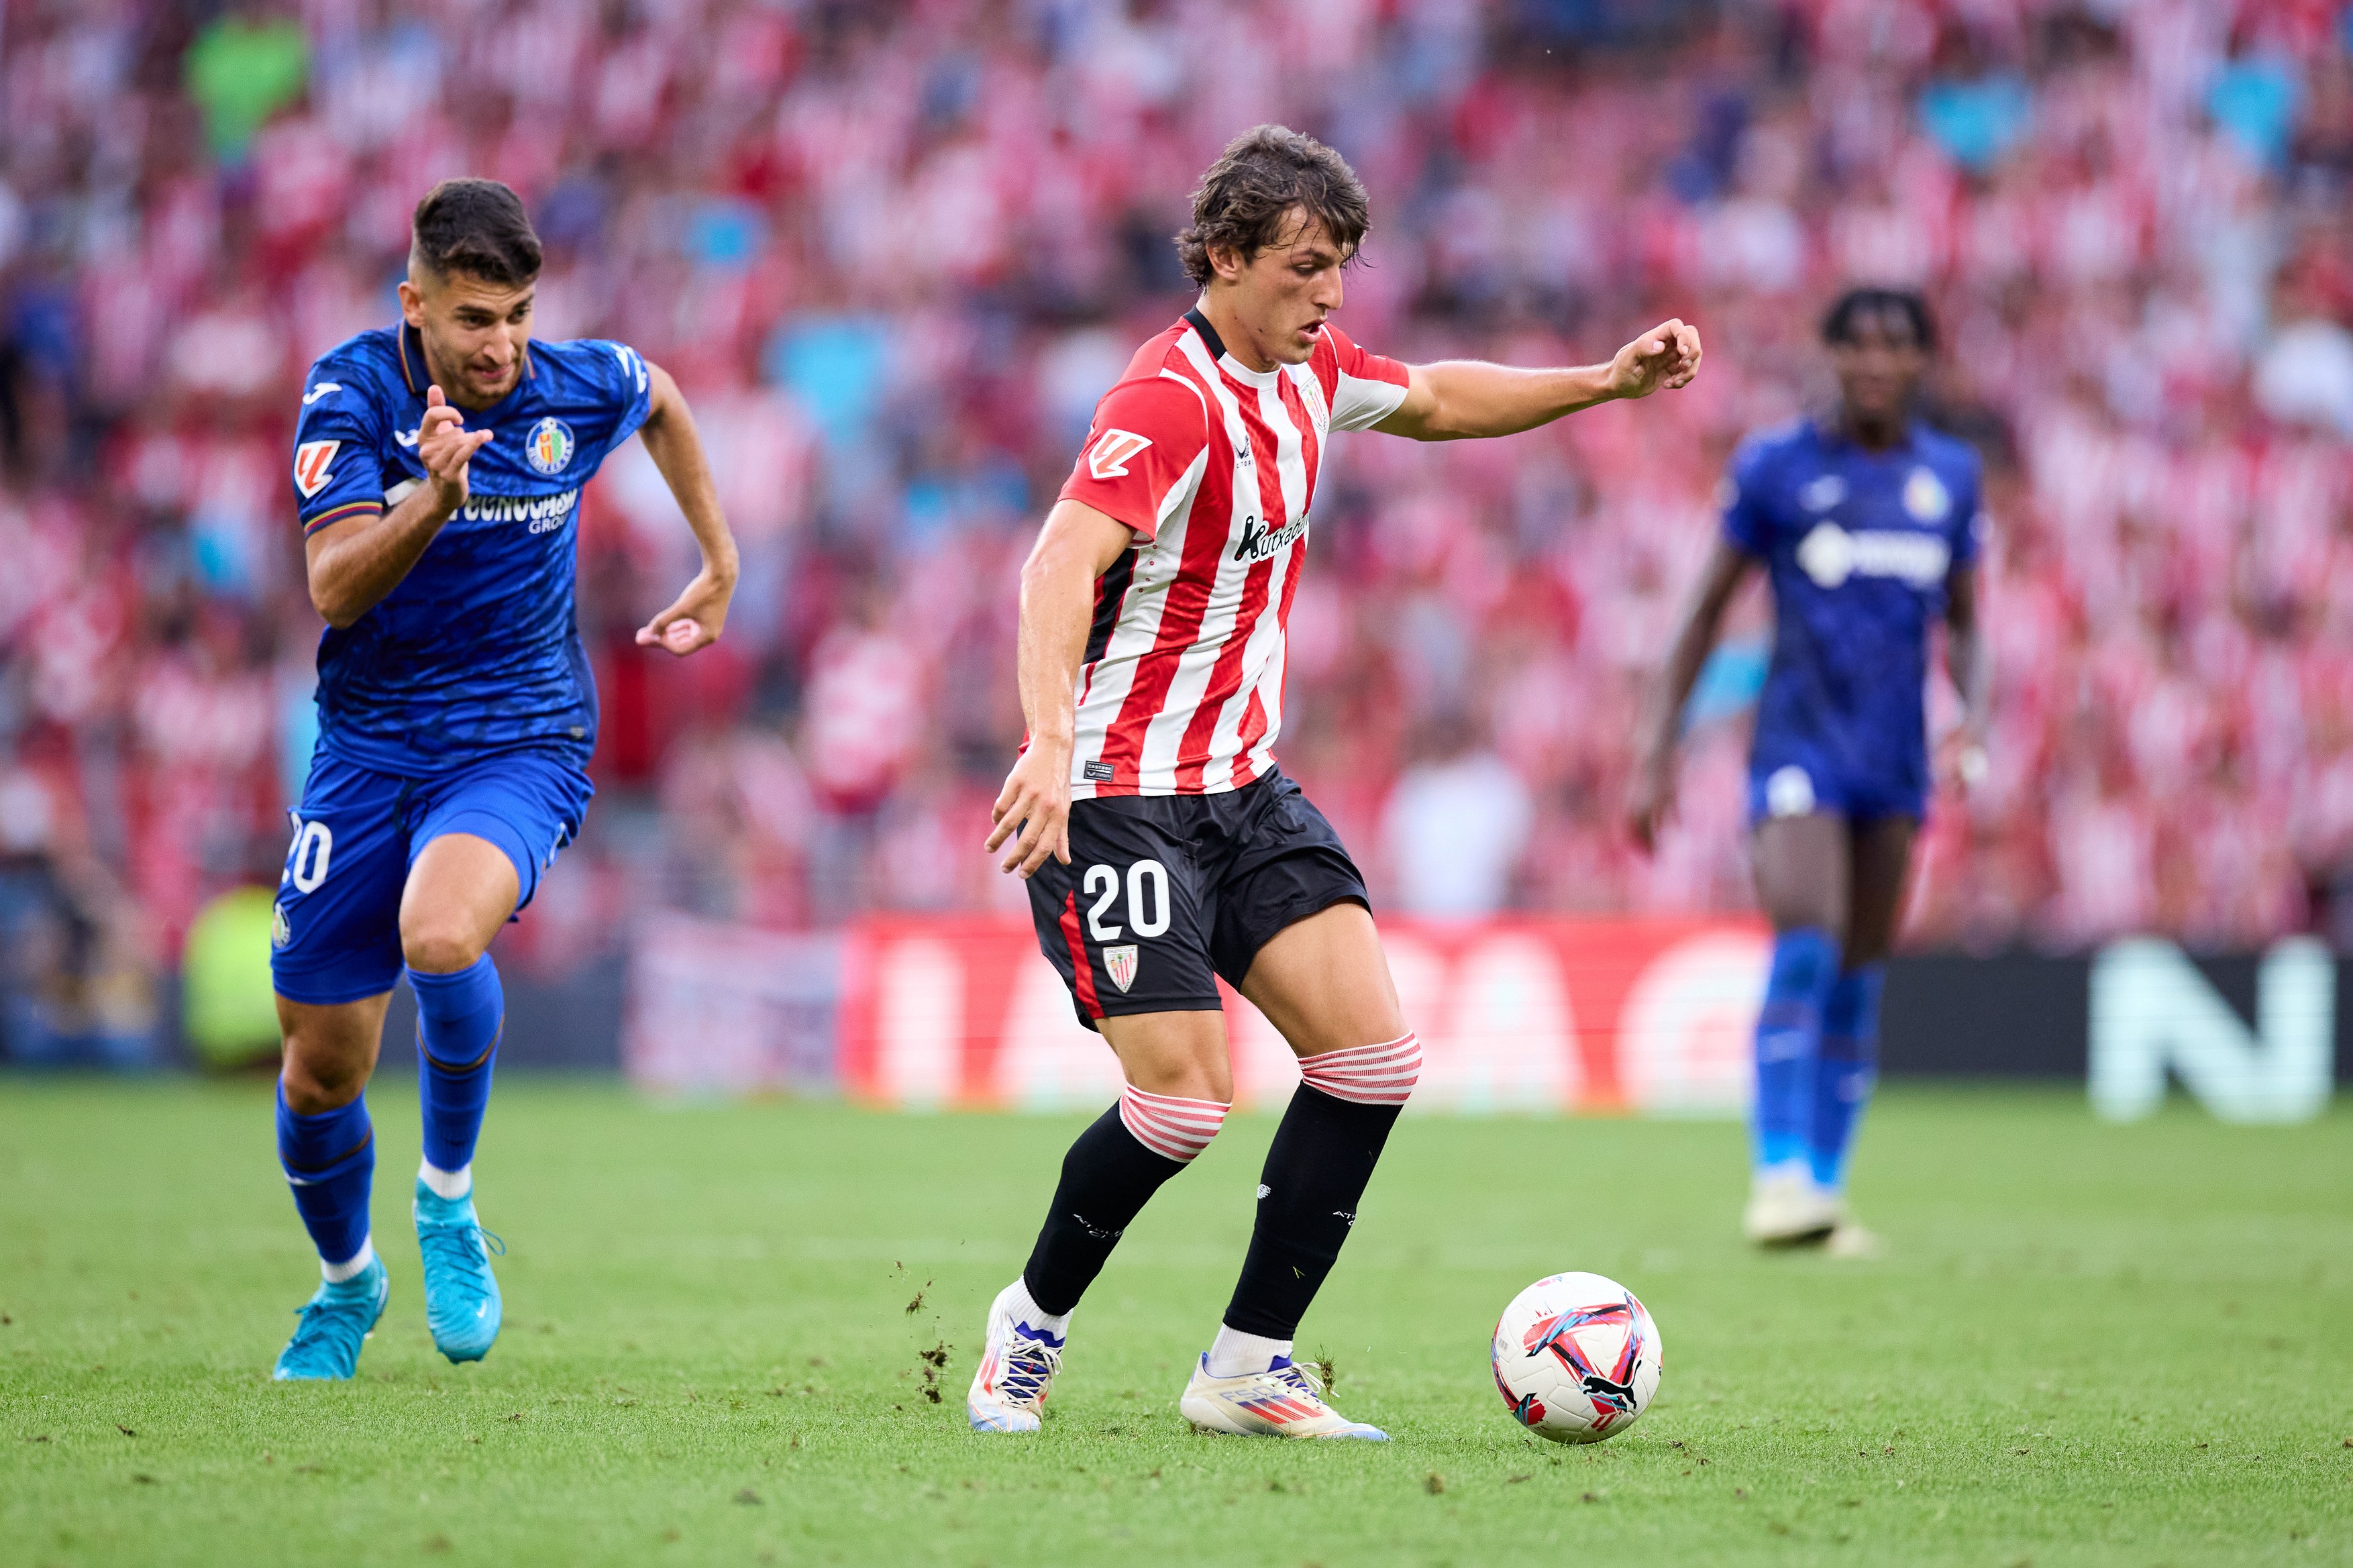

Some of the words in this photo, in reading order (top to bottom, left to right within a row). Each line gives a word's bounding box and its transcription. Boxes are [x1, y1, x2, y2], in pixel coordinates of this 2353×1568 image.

[1083, 859, 1171, 942] 20
[2089, 937, 2335, 1122] N
[1219, 1386, 1277, 1402] F50
